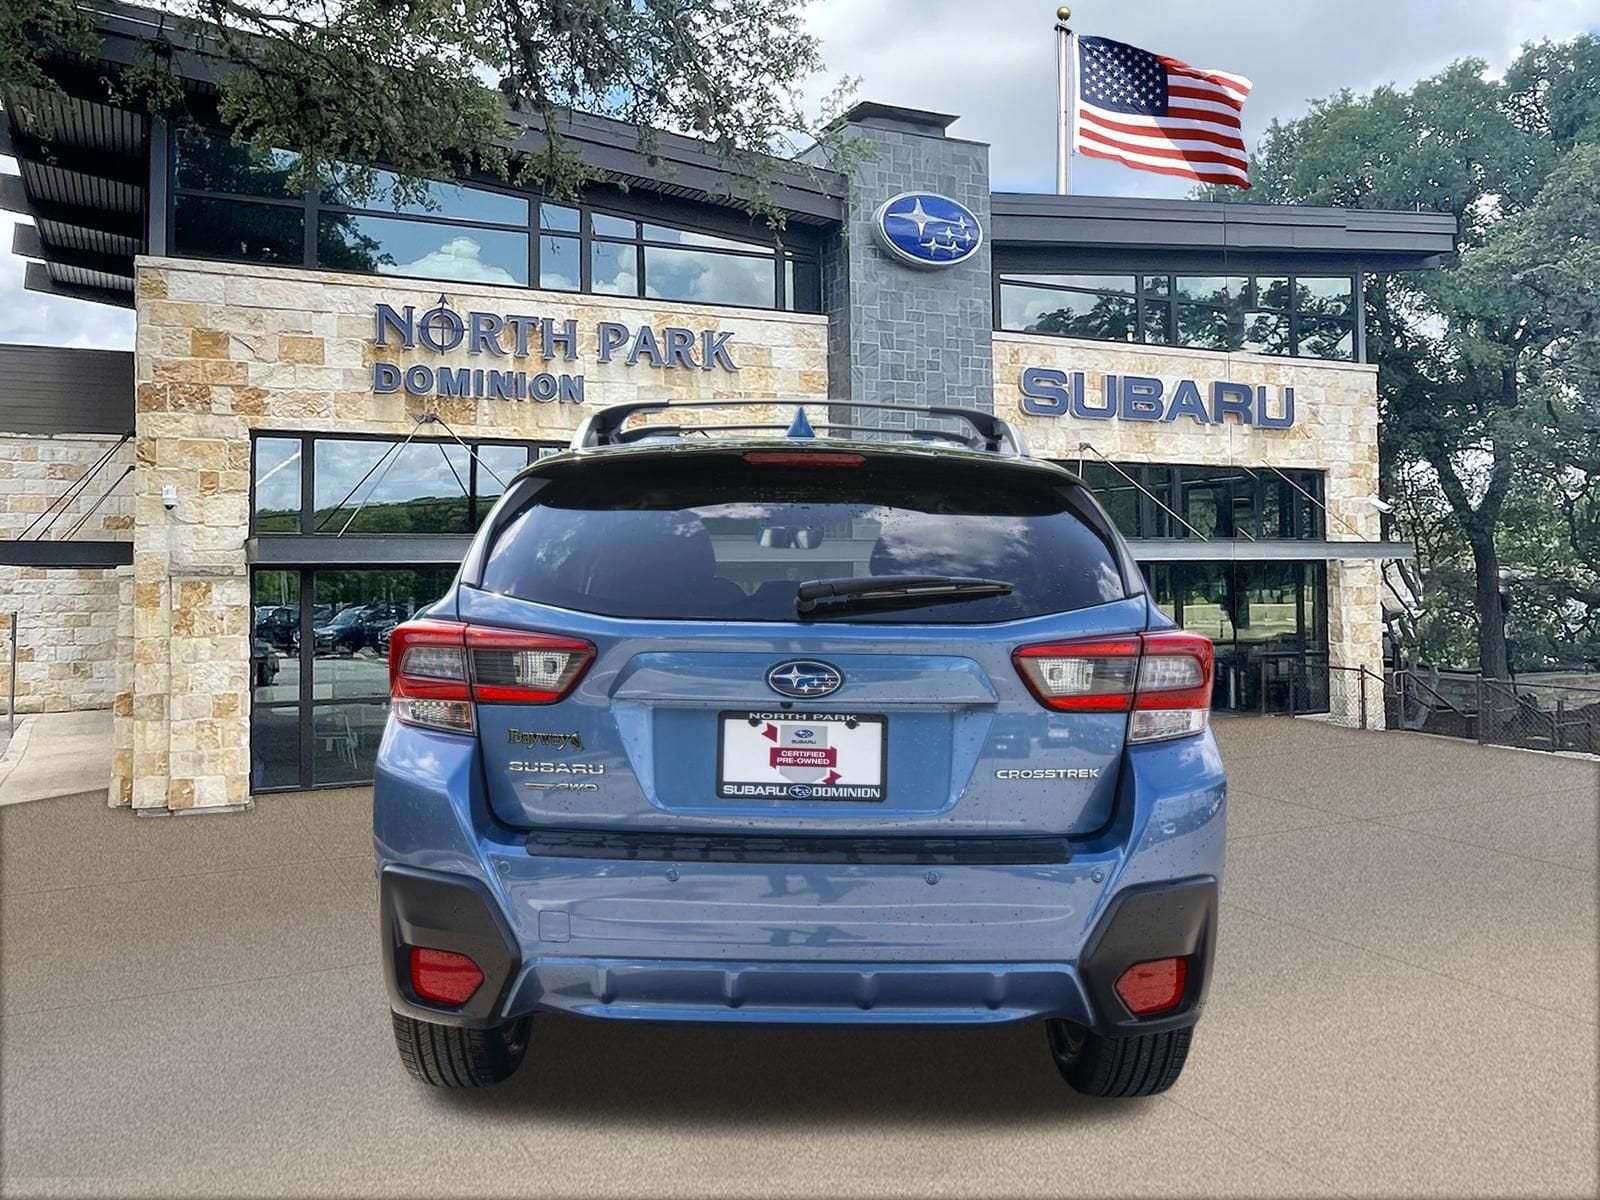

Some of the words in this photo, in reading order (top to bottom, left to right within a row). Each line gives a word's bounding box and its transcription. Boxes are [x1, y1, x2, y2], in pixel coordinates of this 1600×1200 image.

[375, 302, 579, 361] NORTH
[596, 321, 741, 373] PARK
[373, 362, 585, 404] DOMINION
[1019, 367, 1295, 430] SUBARU
[749, 712, 807, 721] NORTH
[813, 713, 858, 722] PARK
[776, 757, 830, 765] PRE-OWNED
[781, 750, 826, 758] CERTIFIED
[509, 761, 605, 775] SUBARU
[996, 768, 1100, 779] CROSSTREK
[723, 784, 788, 796] SUBARU
[812, 786, 881, 798] DOMINION
